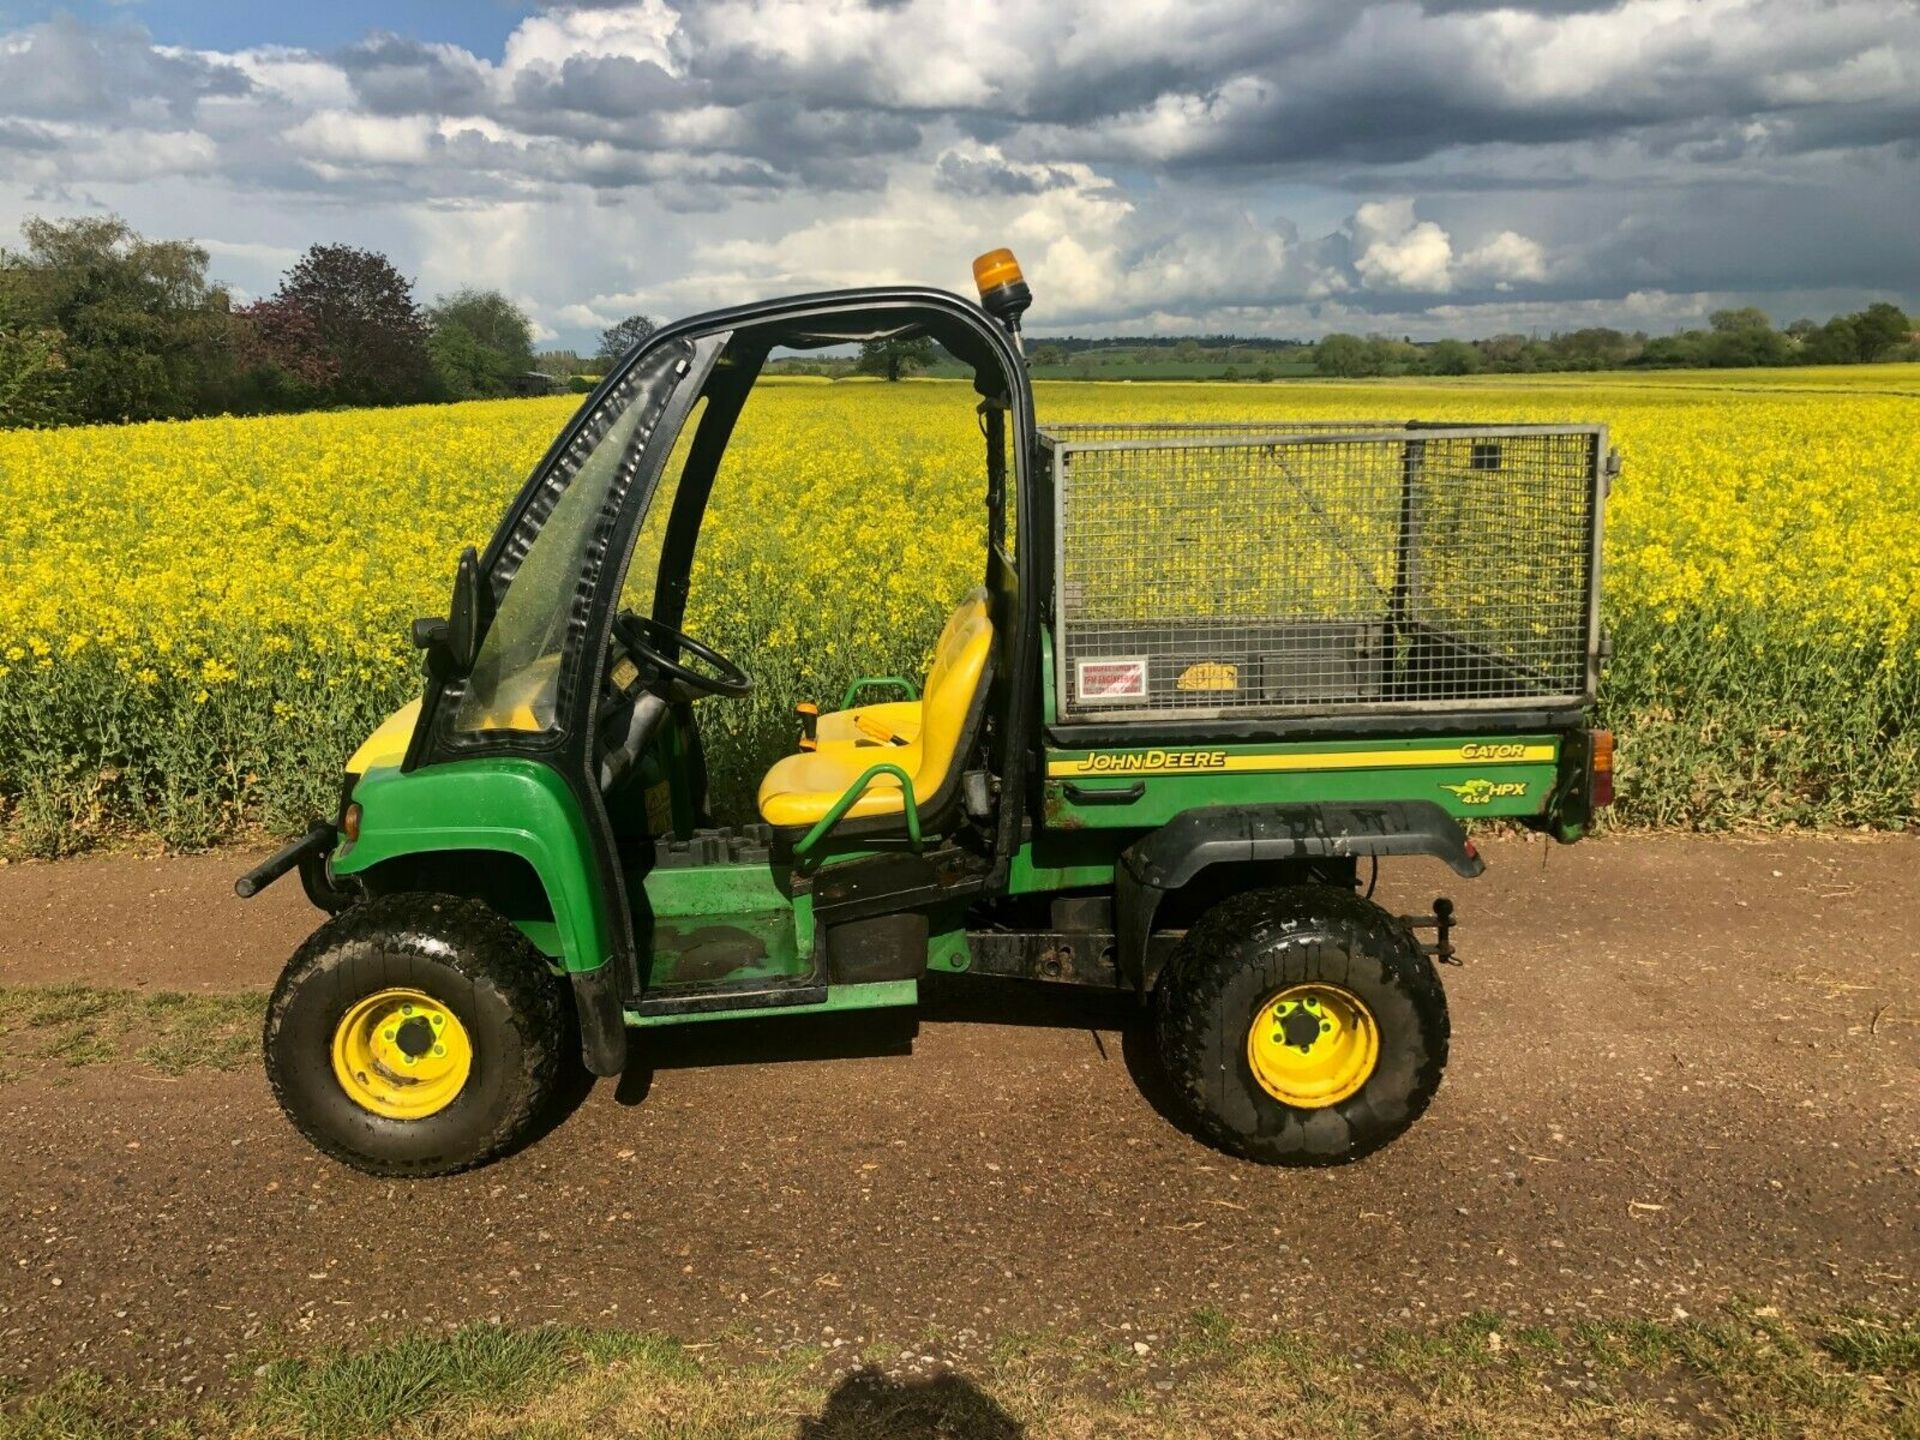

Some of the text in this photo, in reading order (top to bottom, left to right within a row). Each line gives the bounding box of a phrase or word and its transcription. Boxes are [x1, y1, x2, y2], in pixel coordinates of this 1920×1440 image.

[1461, 744, 1524, 759] GATOR
[1078, 750, 1226, 771] JOHN DEERE
[1489, 783, 1526, 796] HPX
[1462, 795, 1490, 804] 4x4
